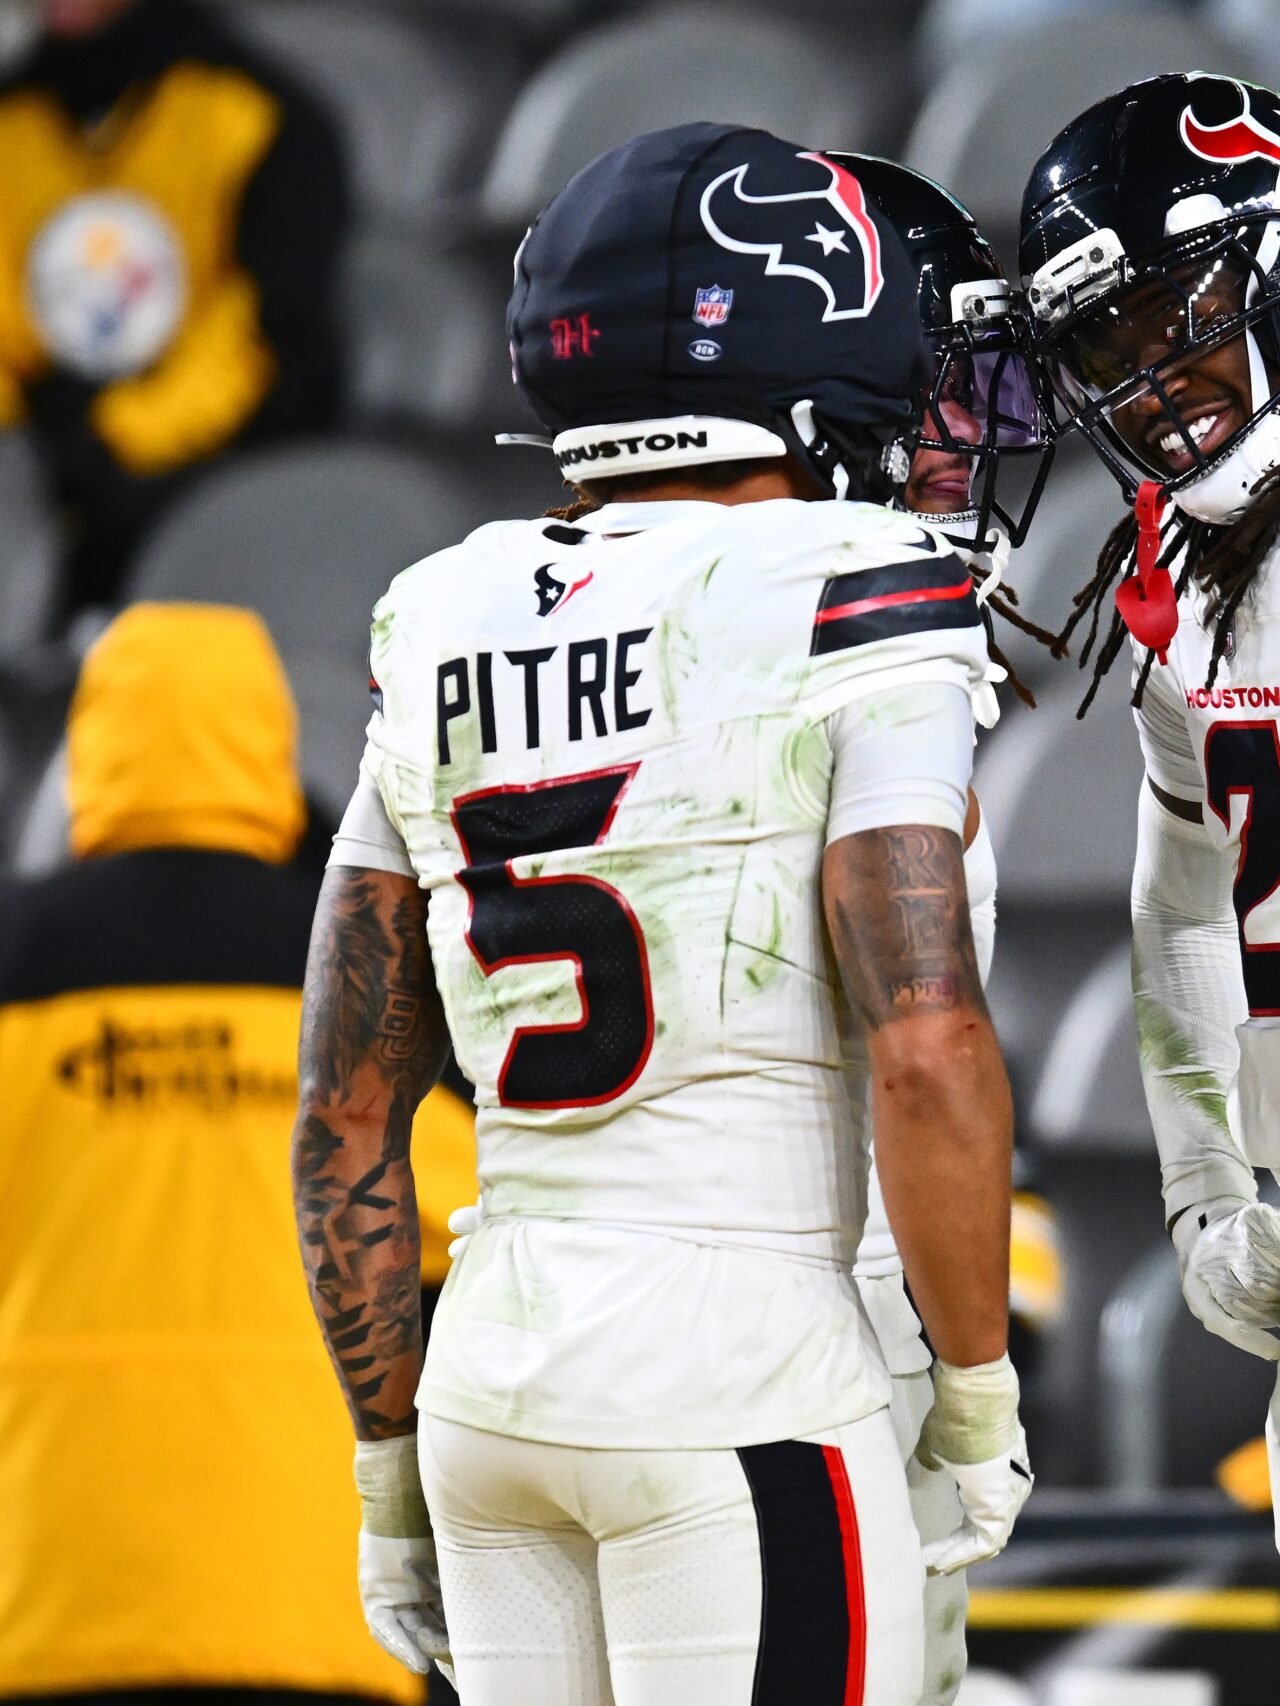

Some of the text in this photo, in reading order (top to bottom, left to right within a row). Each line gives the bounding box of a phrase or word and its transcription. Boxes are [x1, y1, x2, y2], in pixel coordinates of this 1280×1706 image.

[697, 303, 726, 319] NFL
[556, 431, 708, 468] HOUSTON
[436, 627, 655, 766] PITRE
[1184, 686, 1280, 708] HOUSTON
[448, 760, 656, 1108] 5
